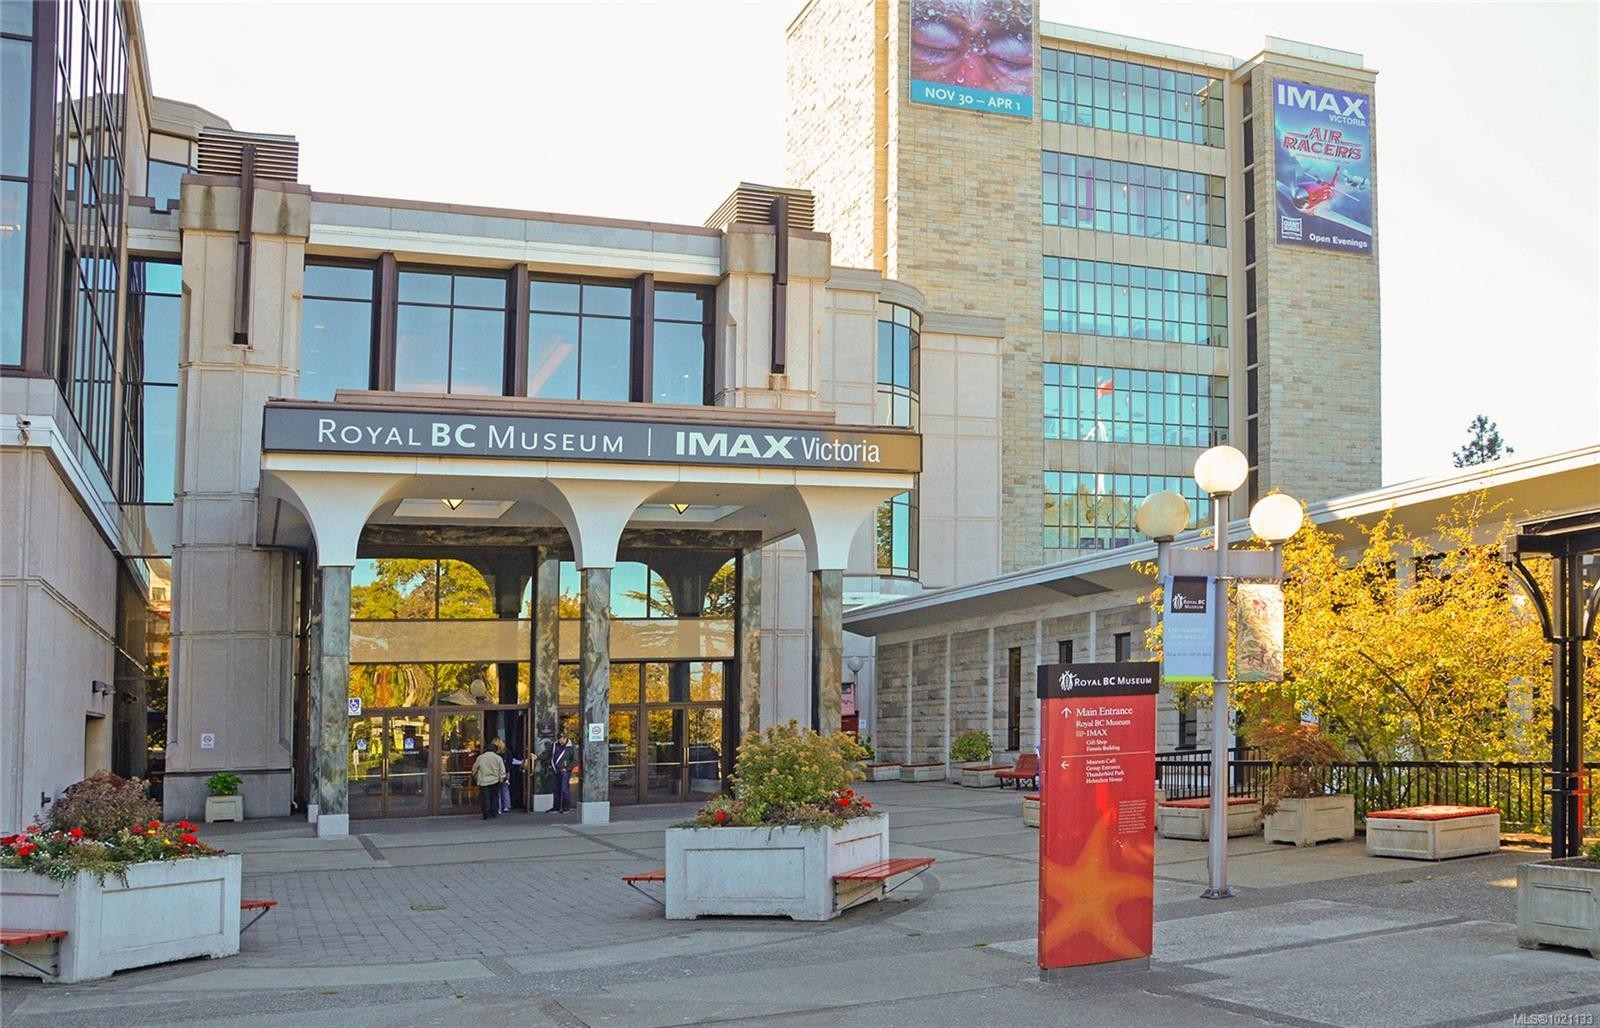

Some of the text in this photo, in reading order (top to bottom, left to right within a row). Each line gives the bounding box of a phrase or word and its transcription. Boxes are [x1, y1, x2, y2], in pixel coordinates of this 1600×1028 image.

[925, 86, 956, 101] NOV
[959, 94, 973, 105] 30
[988, 97, 1013, 109] APR
[1015, 102, 1021, 111] 1
[1277, 84, 1366, 120] IMAX
[1328, 113, 1366, 128] VICTORIA
[1308, 127, 1343, 143] AIR
[1283, 136, 1362, 160] RACERS
[1309, 232, 1331, 243] Open
[1332, 236, 1368, 249] Evenings
[317, 418, 881, 463] ROYAL BC MUSEUM IMAX Victoria
[1074, 676, 1152, 687] ROYAL BC MUSEUM
[1076, 706, 1133, 717] Main Entrance
[1075, 720, 1094, 728] Royal
[1094, 719, 1105, 727] BC
